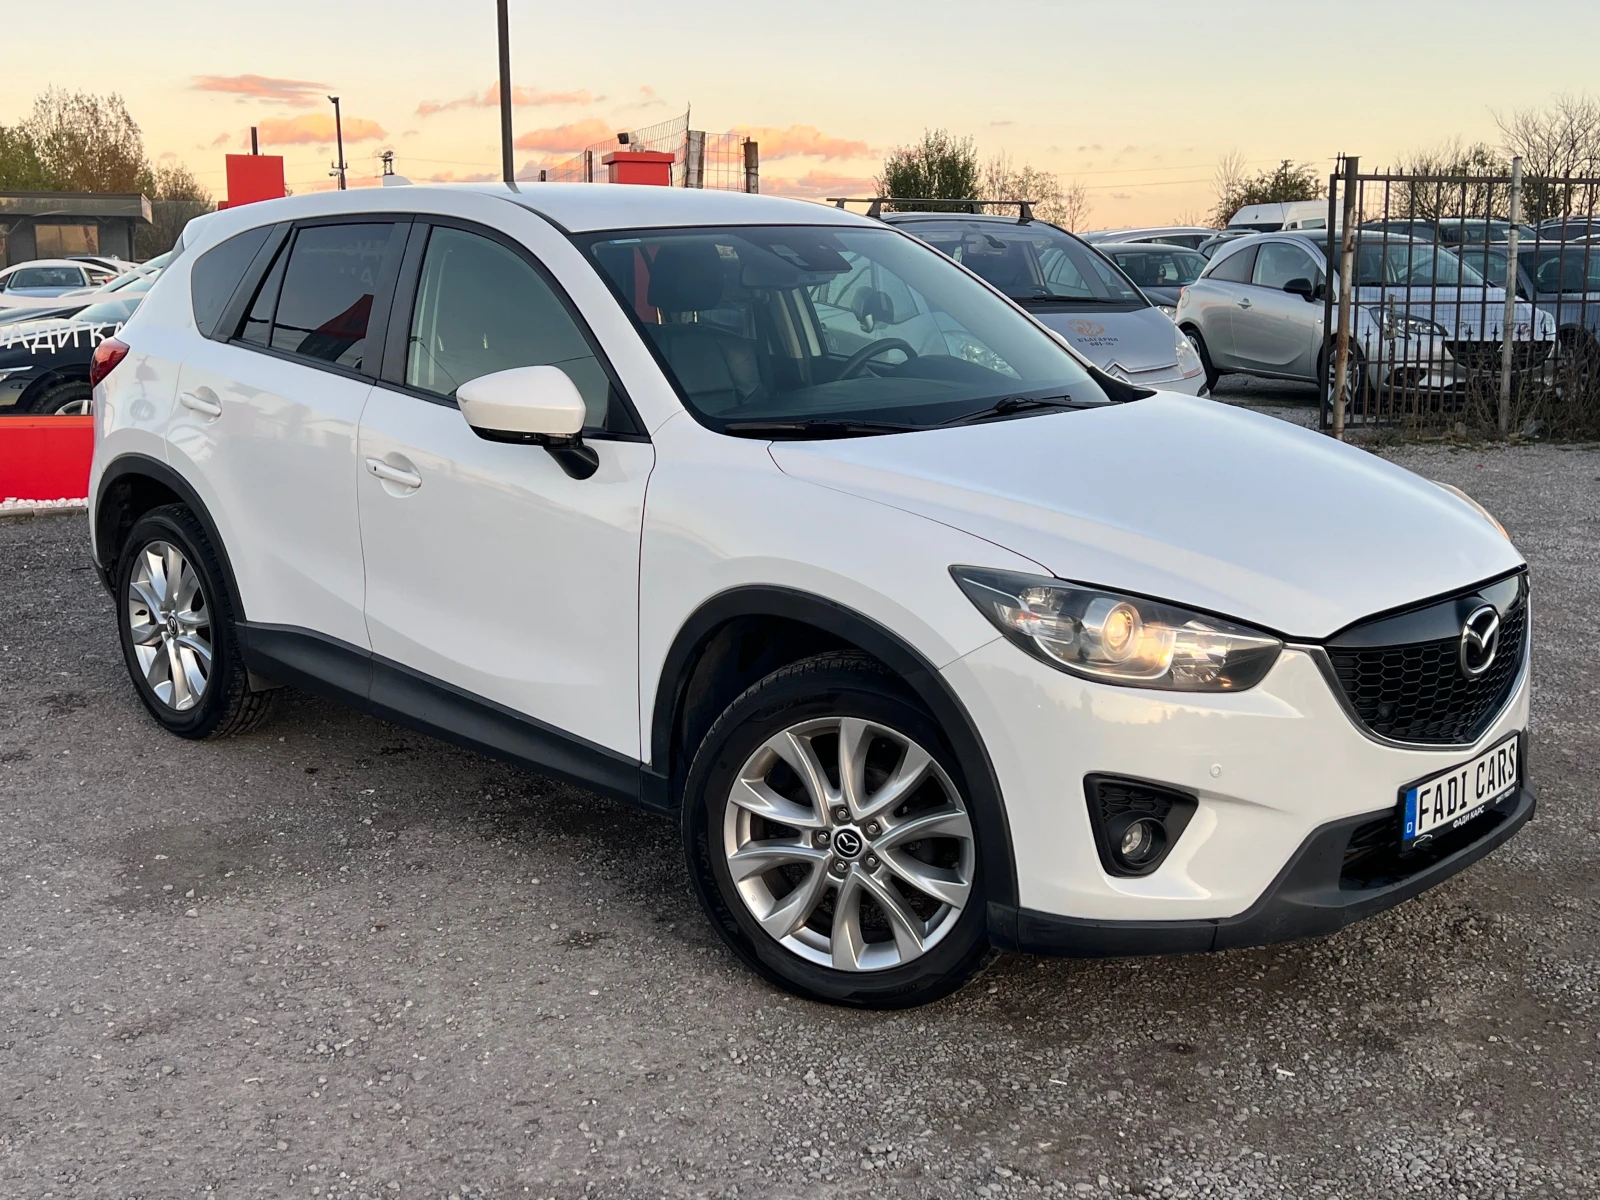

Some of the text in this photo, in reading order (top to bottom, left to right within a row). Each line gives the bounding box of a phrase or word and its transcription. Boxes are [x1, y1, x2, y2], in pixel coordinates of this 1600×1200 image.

[1418, 742, 1515, 831] FADI CARS
[1406, 822, 1413, 833] D
[1452, 805, 1485, 829] ФАДИ КАРС
